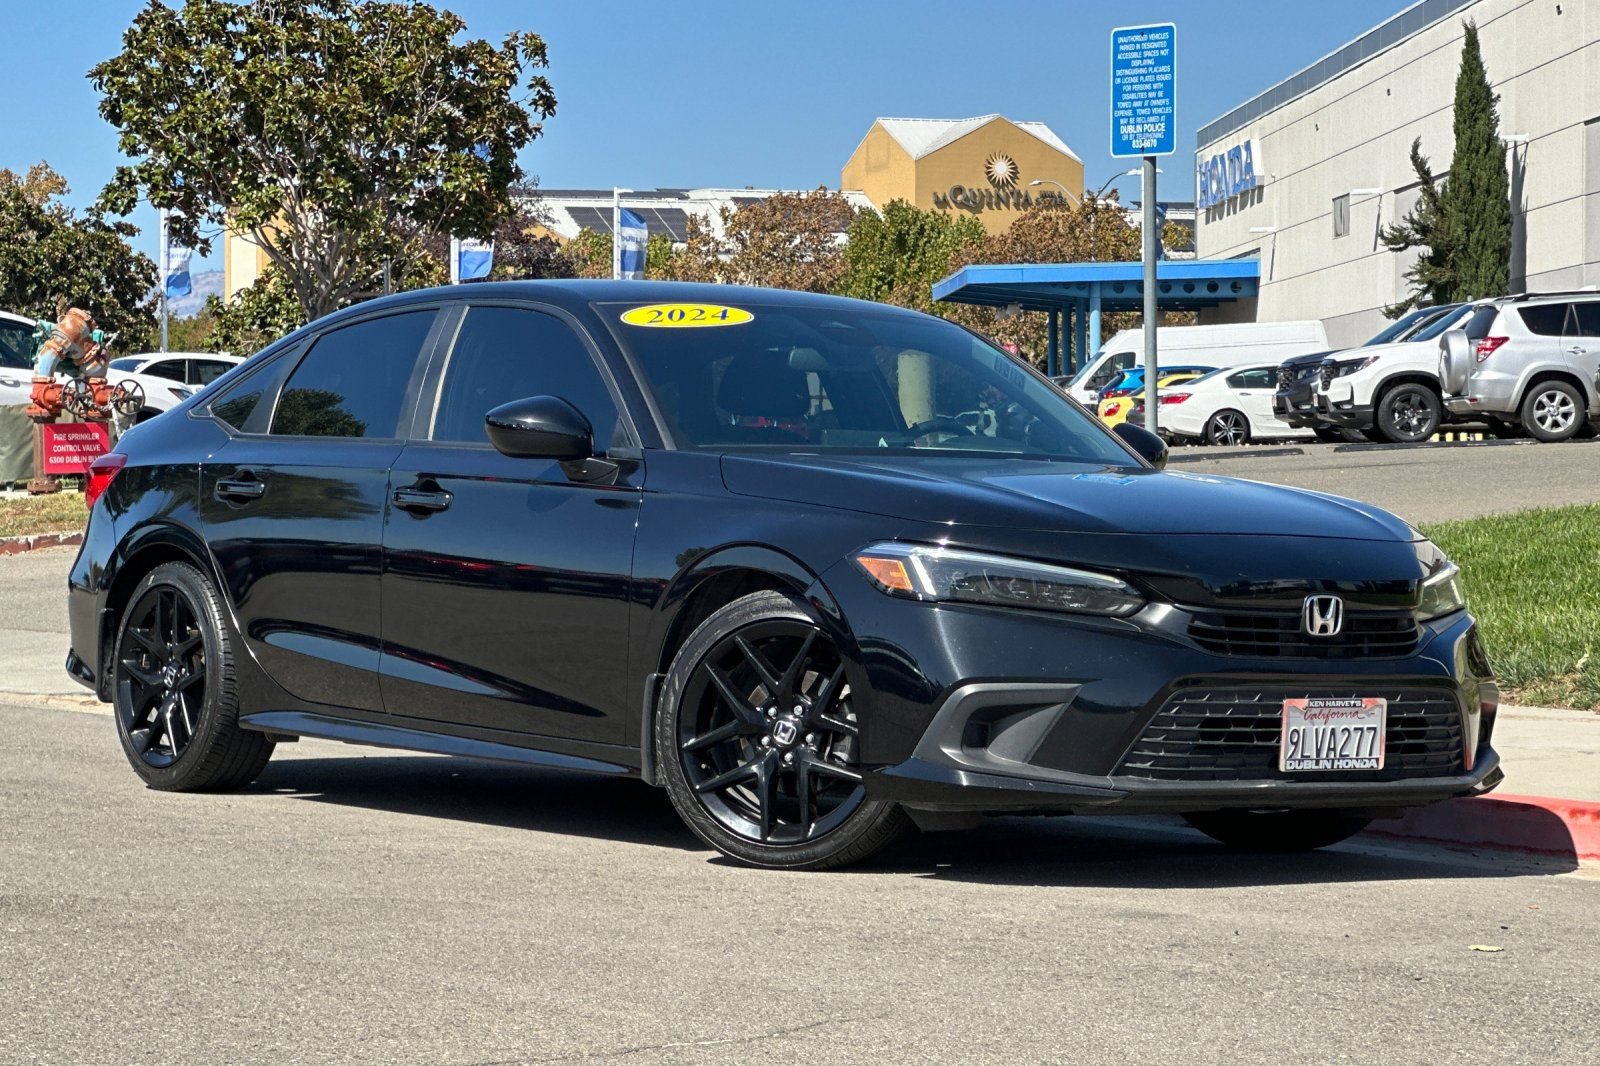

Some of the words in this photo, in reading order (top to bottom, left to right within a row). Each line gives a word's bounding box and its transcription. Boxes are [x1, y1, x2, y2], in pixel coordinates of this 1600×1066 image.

[1149, 32, 1169, 40] VEHICLES
[1141, 41, 1167, 49] DESIGNATED
[1118, 51, 1142, 59] ACCESSIBLE
[1131, 58, 1155, 66] DISPLAYING
[1116, 67, 1148, 76] DISTINGUISHING
[1148, 65, 1171, 73] PLACARDS
[1156, 73, 1172, 81] ISSUED
[1132, 83, 1152, 91] PERSONS
[1122, 92, 1148, 100] DISABILITIES
[1152, 106, 1172, 114] VEHICLES
[1120, 124, 1142, 134] DUBLIN
[1143, 122, 1166, 132] POLICE
[950, 184, 1032, 209] QUINTA
[647, 308, 730, 324] 2024
[53, 433, 66, 441] FIRE
[68, 432, 100, 440] SPRINKLER
[53, 444, 81, 453] CONTROL
[82, 444, 101, 452] VALVE
[49, 456, 64, 464] 6300
[65, 455, 87, 463] DUBLIN
[1303, 708, 1364, 725] California
[1287, 726, 1377, 758] 9LVA277
[1286, 759, 1331, 770] DUBLIN
[1333, 758, 1378, 769] HONDA
